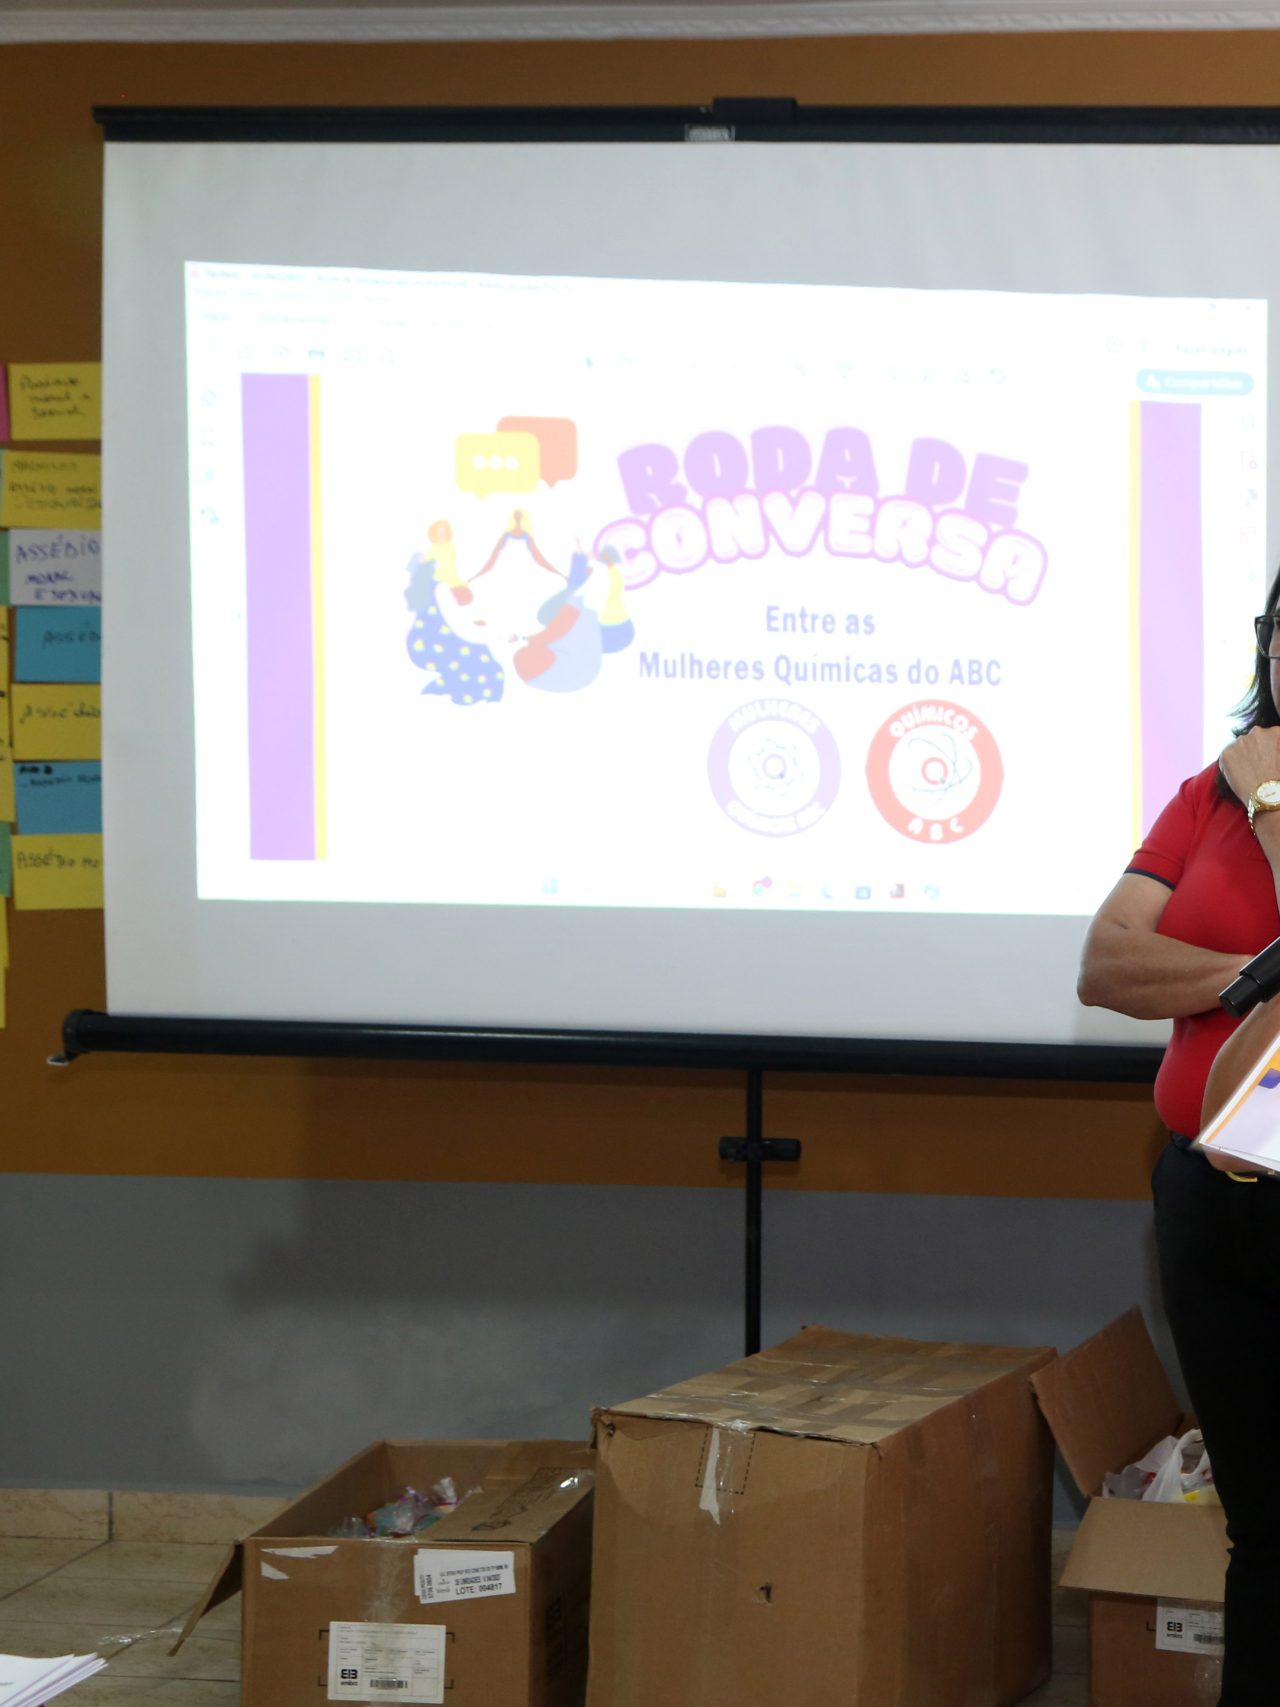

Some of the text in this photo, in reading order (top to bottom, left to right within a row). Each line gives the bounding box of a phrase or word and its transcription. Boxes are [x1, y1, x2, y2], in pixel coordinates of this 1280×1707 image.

[617, 425, 1029, 528] RODA DE
[593, 487, 1048, 607] CONVERSA
[766, 605, 876, 635] Entre as
[640, 651, 765, 681] Mulheres
[907, 658, 940, 685] do
[950, 659, 1001, 687] ABC
